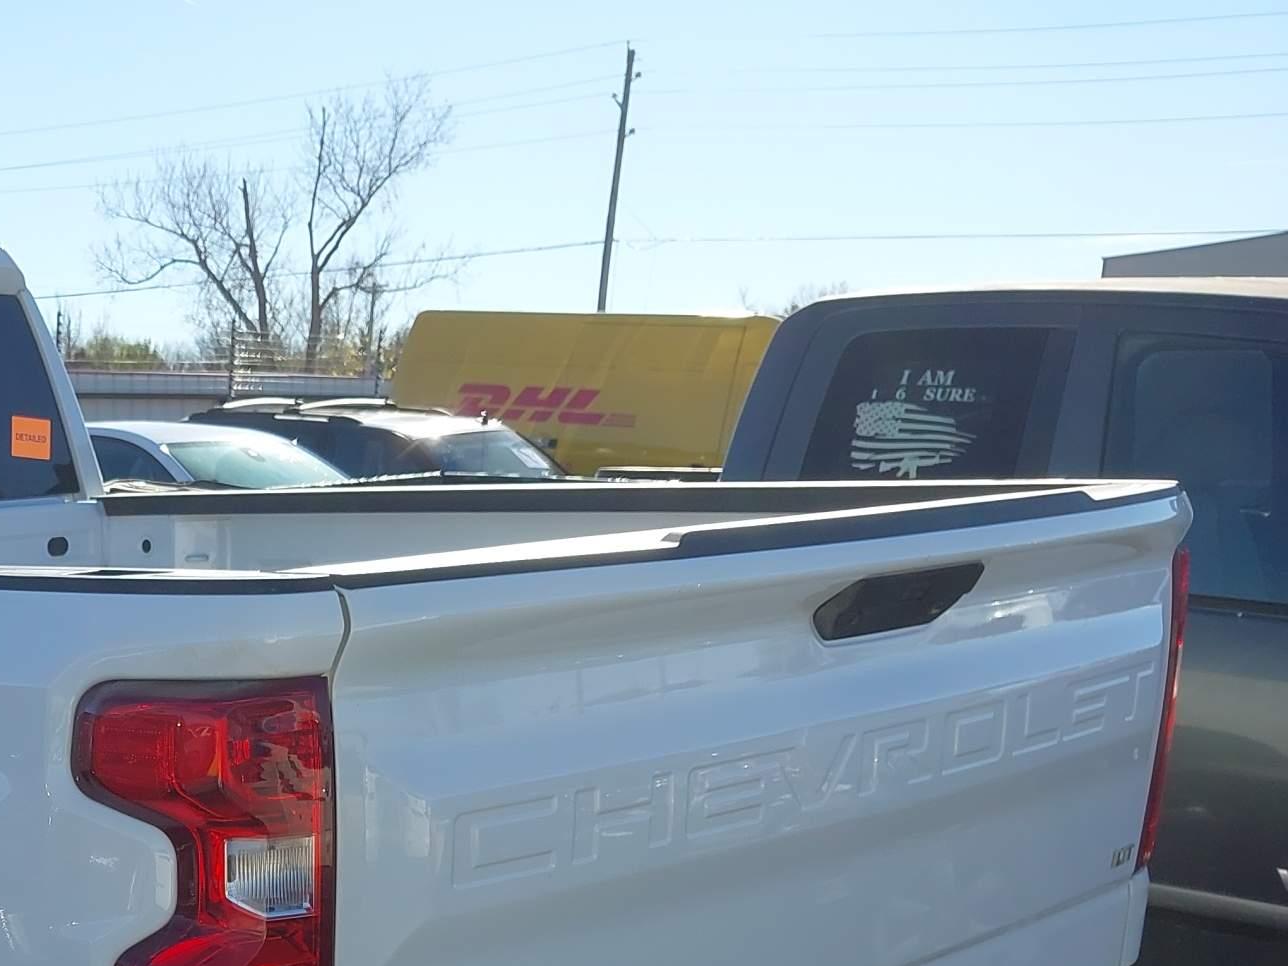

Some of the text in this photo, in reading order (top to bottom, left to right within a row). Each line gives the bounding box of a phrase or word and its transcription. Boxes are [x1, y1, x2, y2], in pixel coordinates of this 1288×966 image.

[900, 369, 955, 386] I AM
[455, 383, 601, 425] DHL
[895, 387, 906, 400] 6
[923, 387, 976, 402] SURE
[451, 660, 1155, 889] CHEVROLET
